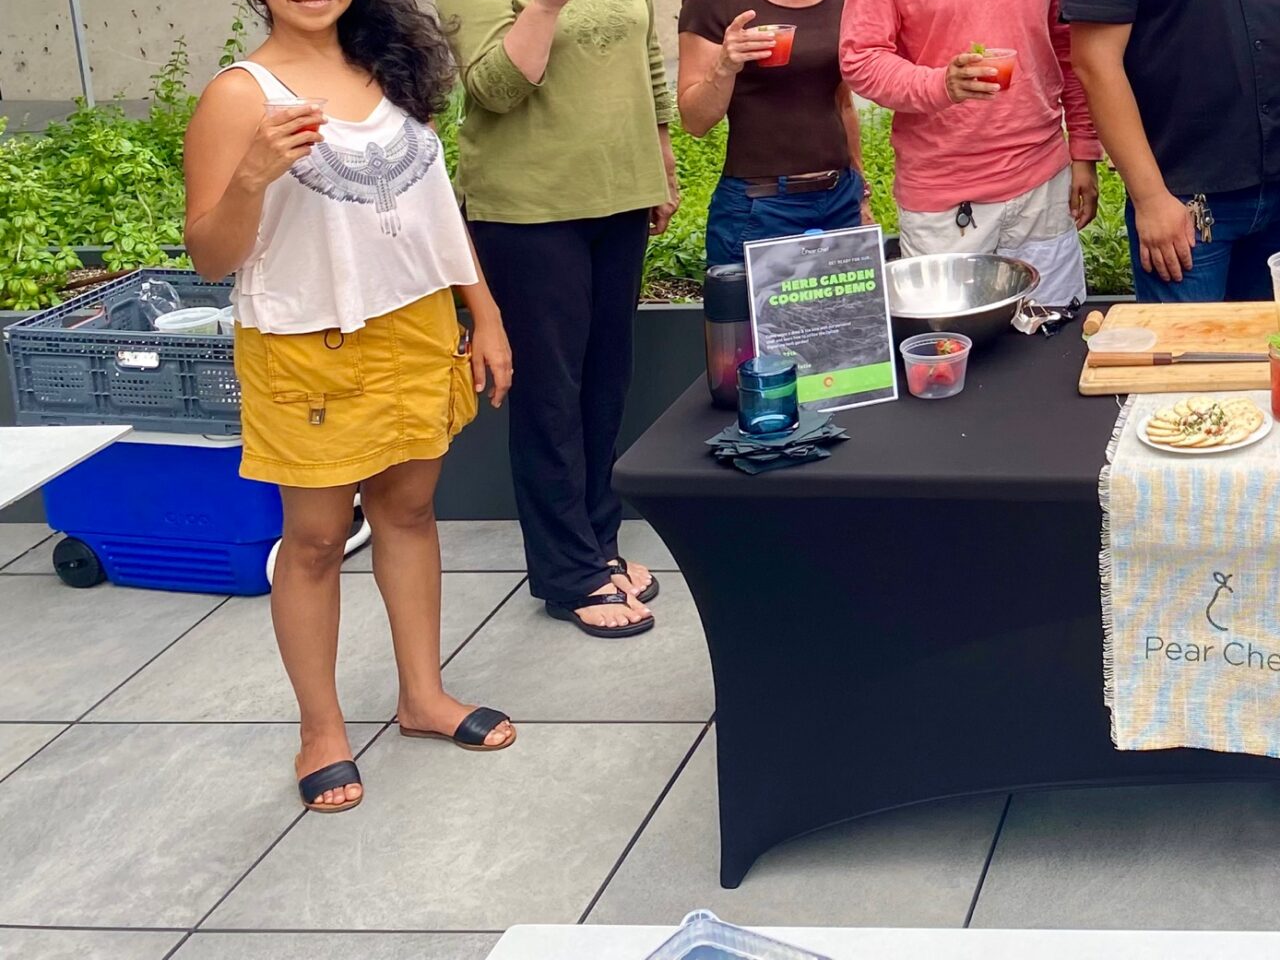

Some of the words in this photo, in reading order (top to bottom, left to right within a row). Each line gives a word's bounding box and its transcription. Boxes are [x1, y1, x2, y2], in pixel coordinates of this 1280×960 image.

[769, 286, 833, 306] COOKING
[835, 280, 876, 296] DEMO
[782, 277, 817, 292] HERB
[820, 268, 875, 286] GARDEN
[1145, 636, 1214, 662] Pear
